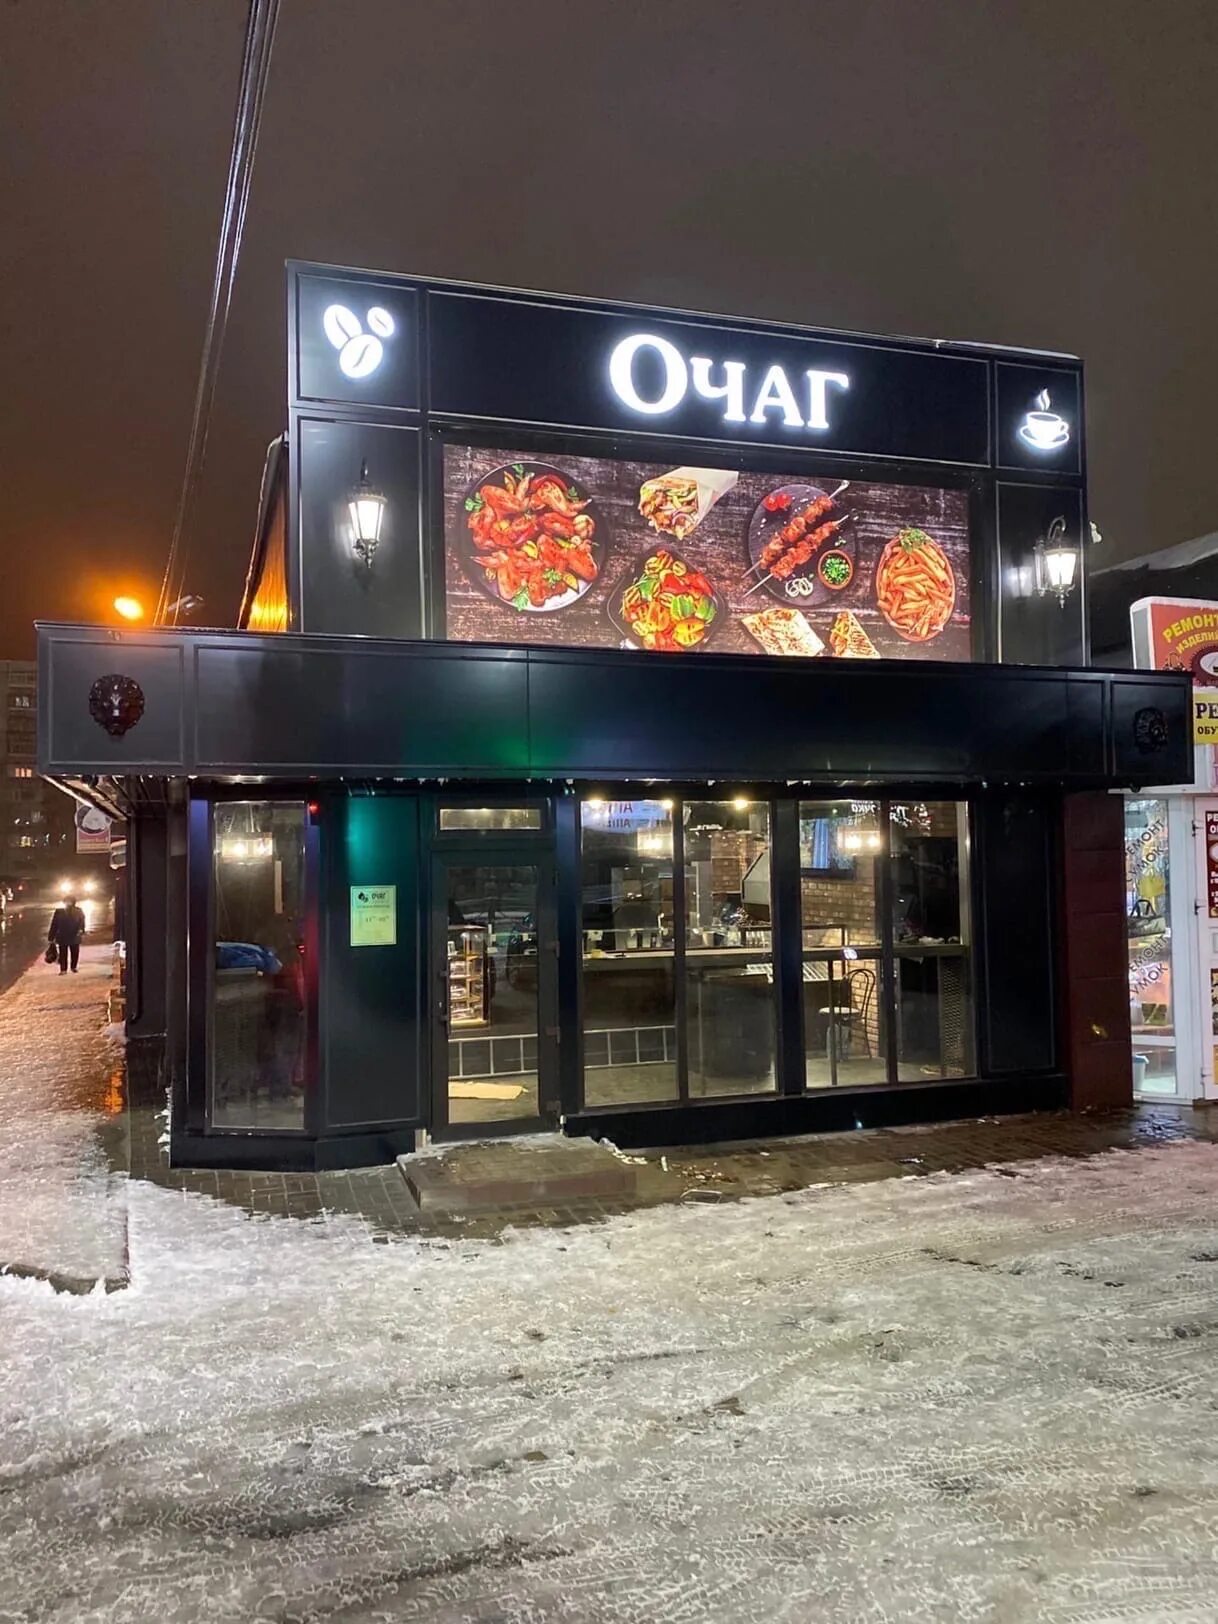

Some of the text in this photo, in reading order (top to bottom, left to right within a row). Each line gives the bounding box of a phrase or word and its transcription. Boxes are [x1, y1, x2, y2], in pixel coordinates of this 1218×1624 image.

[1126, 820, 1164, 856] ЕМОНТ
[1129, 935, 1168, 972] ЕМОНТ
[1130, 963, 1168, 1001] УМОК
